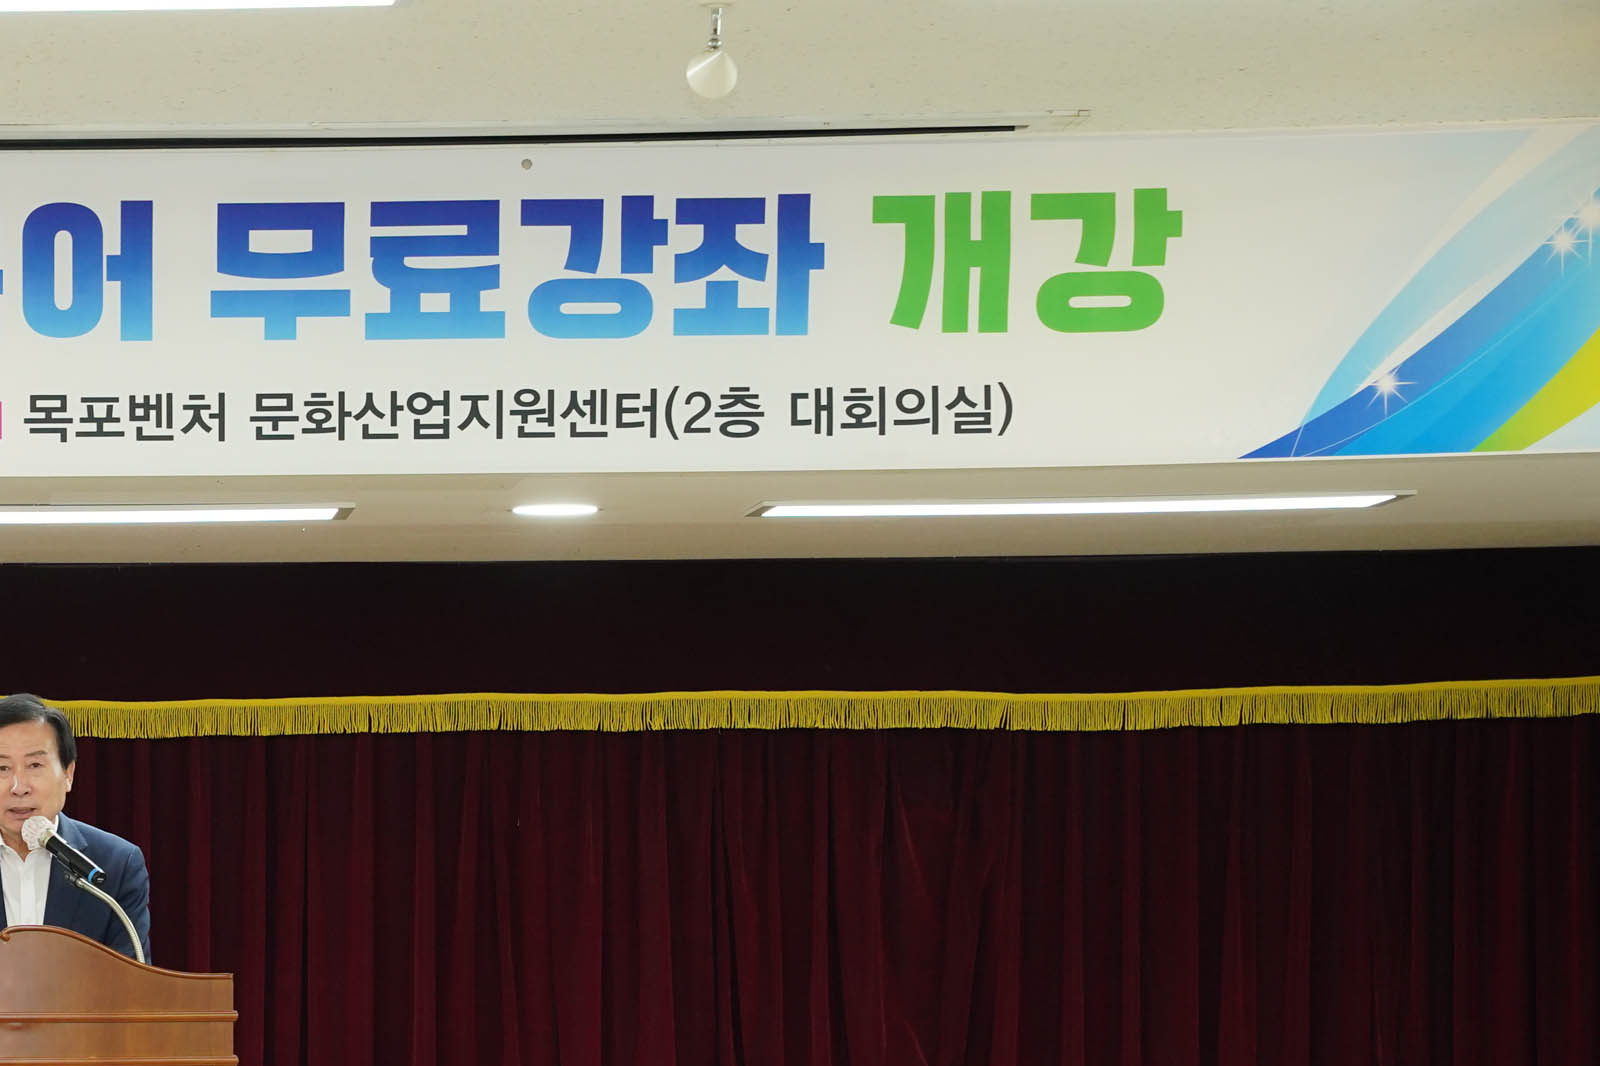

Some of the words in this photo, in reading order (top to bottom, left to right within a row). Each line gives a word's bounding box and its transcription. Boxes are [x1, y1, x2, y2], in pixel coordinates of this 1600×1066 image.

[210, 193, 826, 342] 무료강좌
[871, 186, 1184, 334] 개강
[22, 391, 227, 443] 목포벤처
[248, 385, 766, 442] 문화산업지원센터(2층
[789, 381, 1014, 438] 대회의실)
